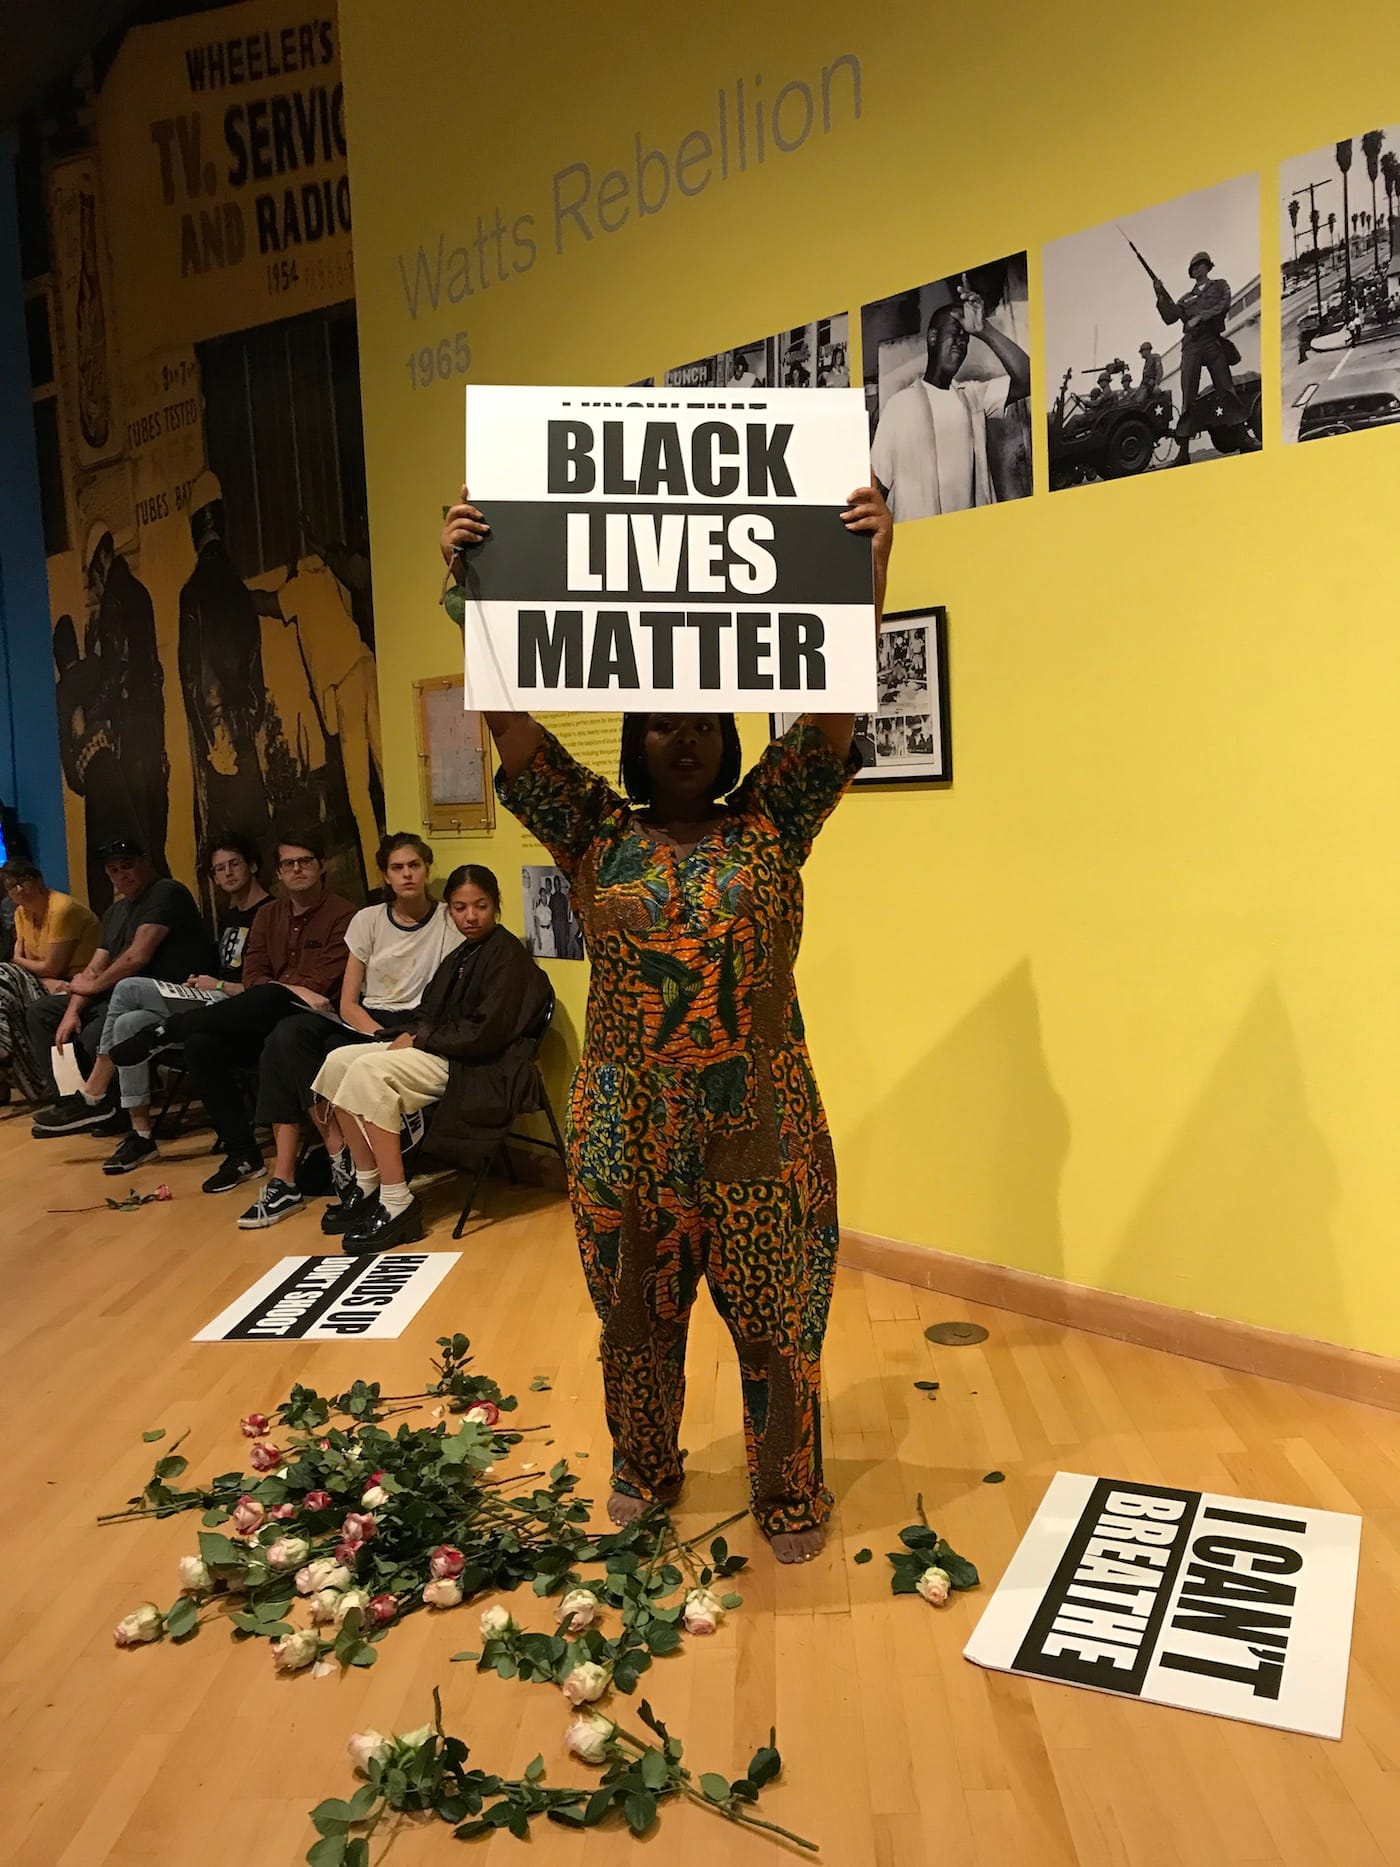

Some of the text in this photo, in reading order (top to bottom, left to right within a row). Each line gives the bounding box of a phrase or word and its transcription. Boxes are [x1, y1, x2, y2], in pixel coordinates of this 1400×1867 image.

[185, 20, 332, 92] WHEELER'S
[399, 54, 862, 320] Watts Rebellion
[181, 201, 246, 279] AND
[406, 331, 472, 390] 1965
[128, 398, 198, 449] TUBES TESTED
[547, 420, 797, 498] BLACK
[137, 491, 169, 528] TUBES
[567, 512, 777, 594] LIVES
[518, 610, 826, 690] MATTER
[247, 1290, 324, 1336] SHOOT
[319, 1254, 430, 1335] HANDS UP
[1040, 1490, 1187, 1671] BREATHE
[1158, 1506, 1307, 1700] I CAN'T
